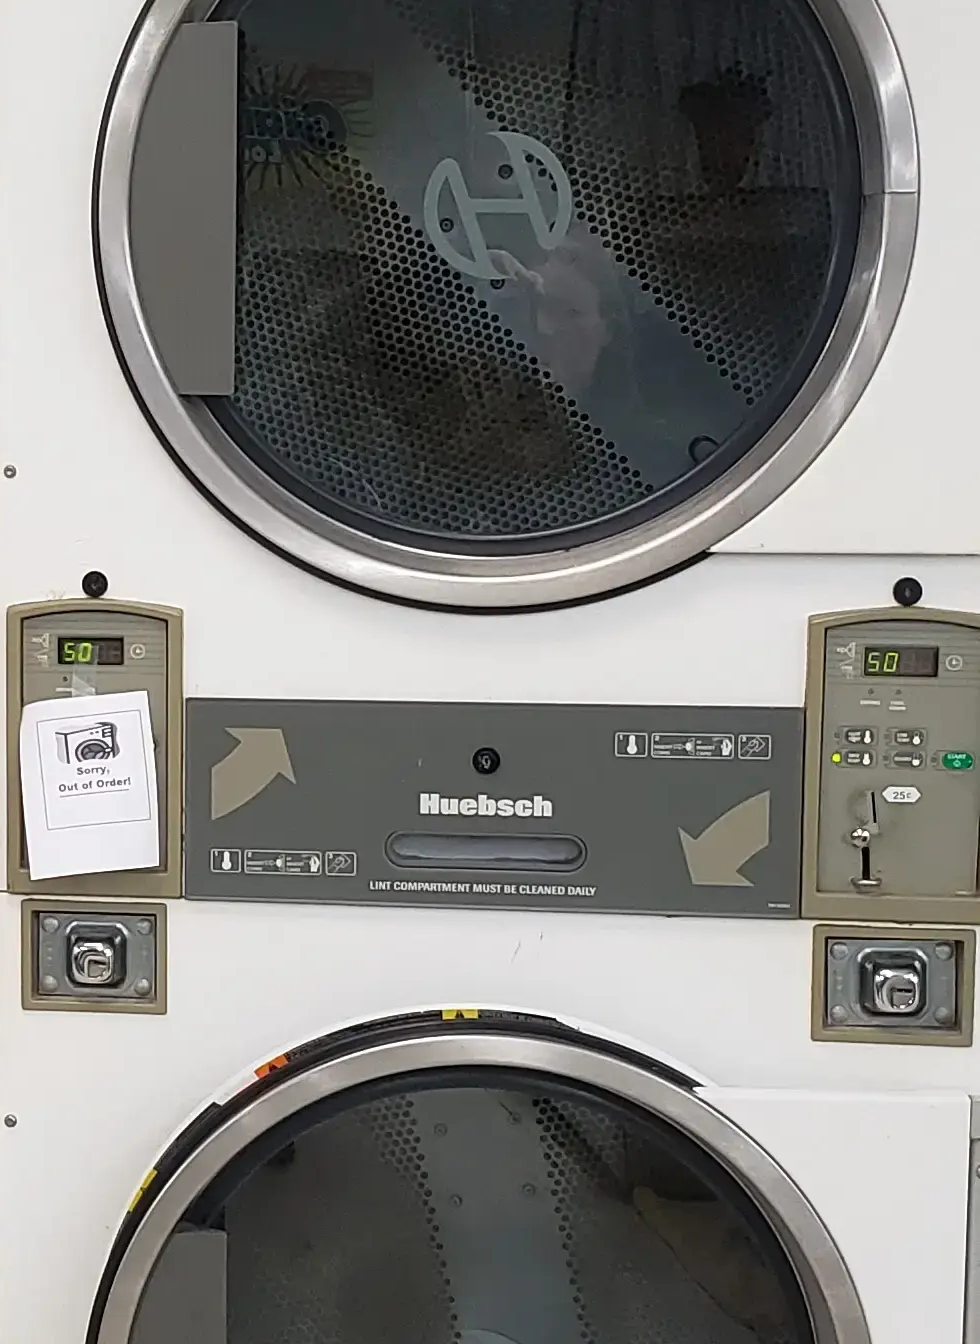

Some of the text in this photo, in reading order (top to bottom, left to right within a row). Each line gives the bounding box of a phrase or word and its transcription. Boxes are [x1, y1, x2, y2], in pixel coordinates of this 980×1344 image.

[63, 642, 92, 663] 50
[867, 652, 899, 673] 50
[76, 766, 110, 776] Sorry,
[58, 776, 131, 792] Out of Order!
[419, 793, 553, 817] Huebsch
[369, 880, 596, 897] LINT COMPARTMENT MUST BE CLEANED DAILY
